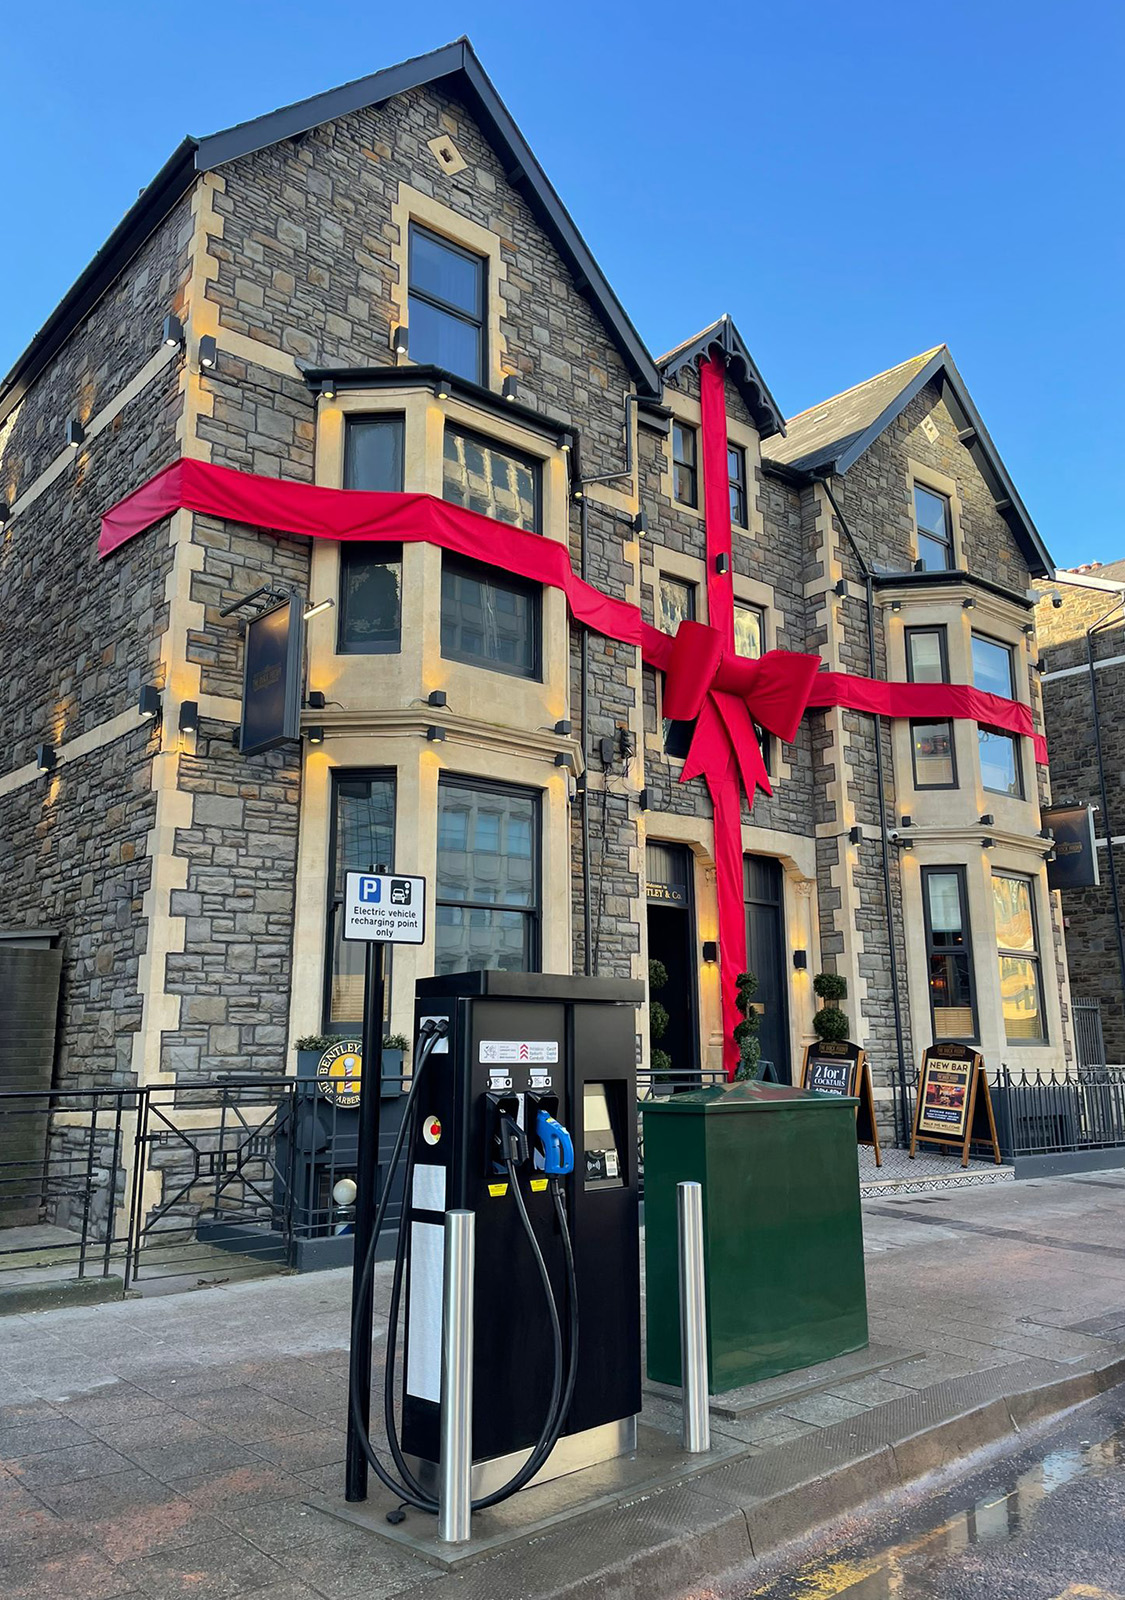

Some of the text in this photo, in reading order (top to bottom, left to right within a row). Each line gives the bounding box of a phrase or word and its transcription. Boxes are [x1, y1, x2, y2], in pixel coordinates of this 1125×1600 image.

[363, 880, 377, 900] P
[646, 889, 663, 898] TLEY
[664, 890, 671, 899] &
[353, 906, 416, 918] Electric vehicle
[350, 917, 418, 928] recharging point
[376, 928, 394, 938] only
[929, 1061, 969, 1072] NEW BAR
[814, 1065, 847, 1081] 2 for 1
[814, 1078, 846, 1087] COCKTAILS
[335, 1095, 361, 1105] ARBER
